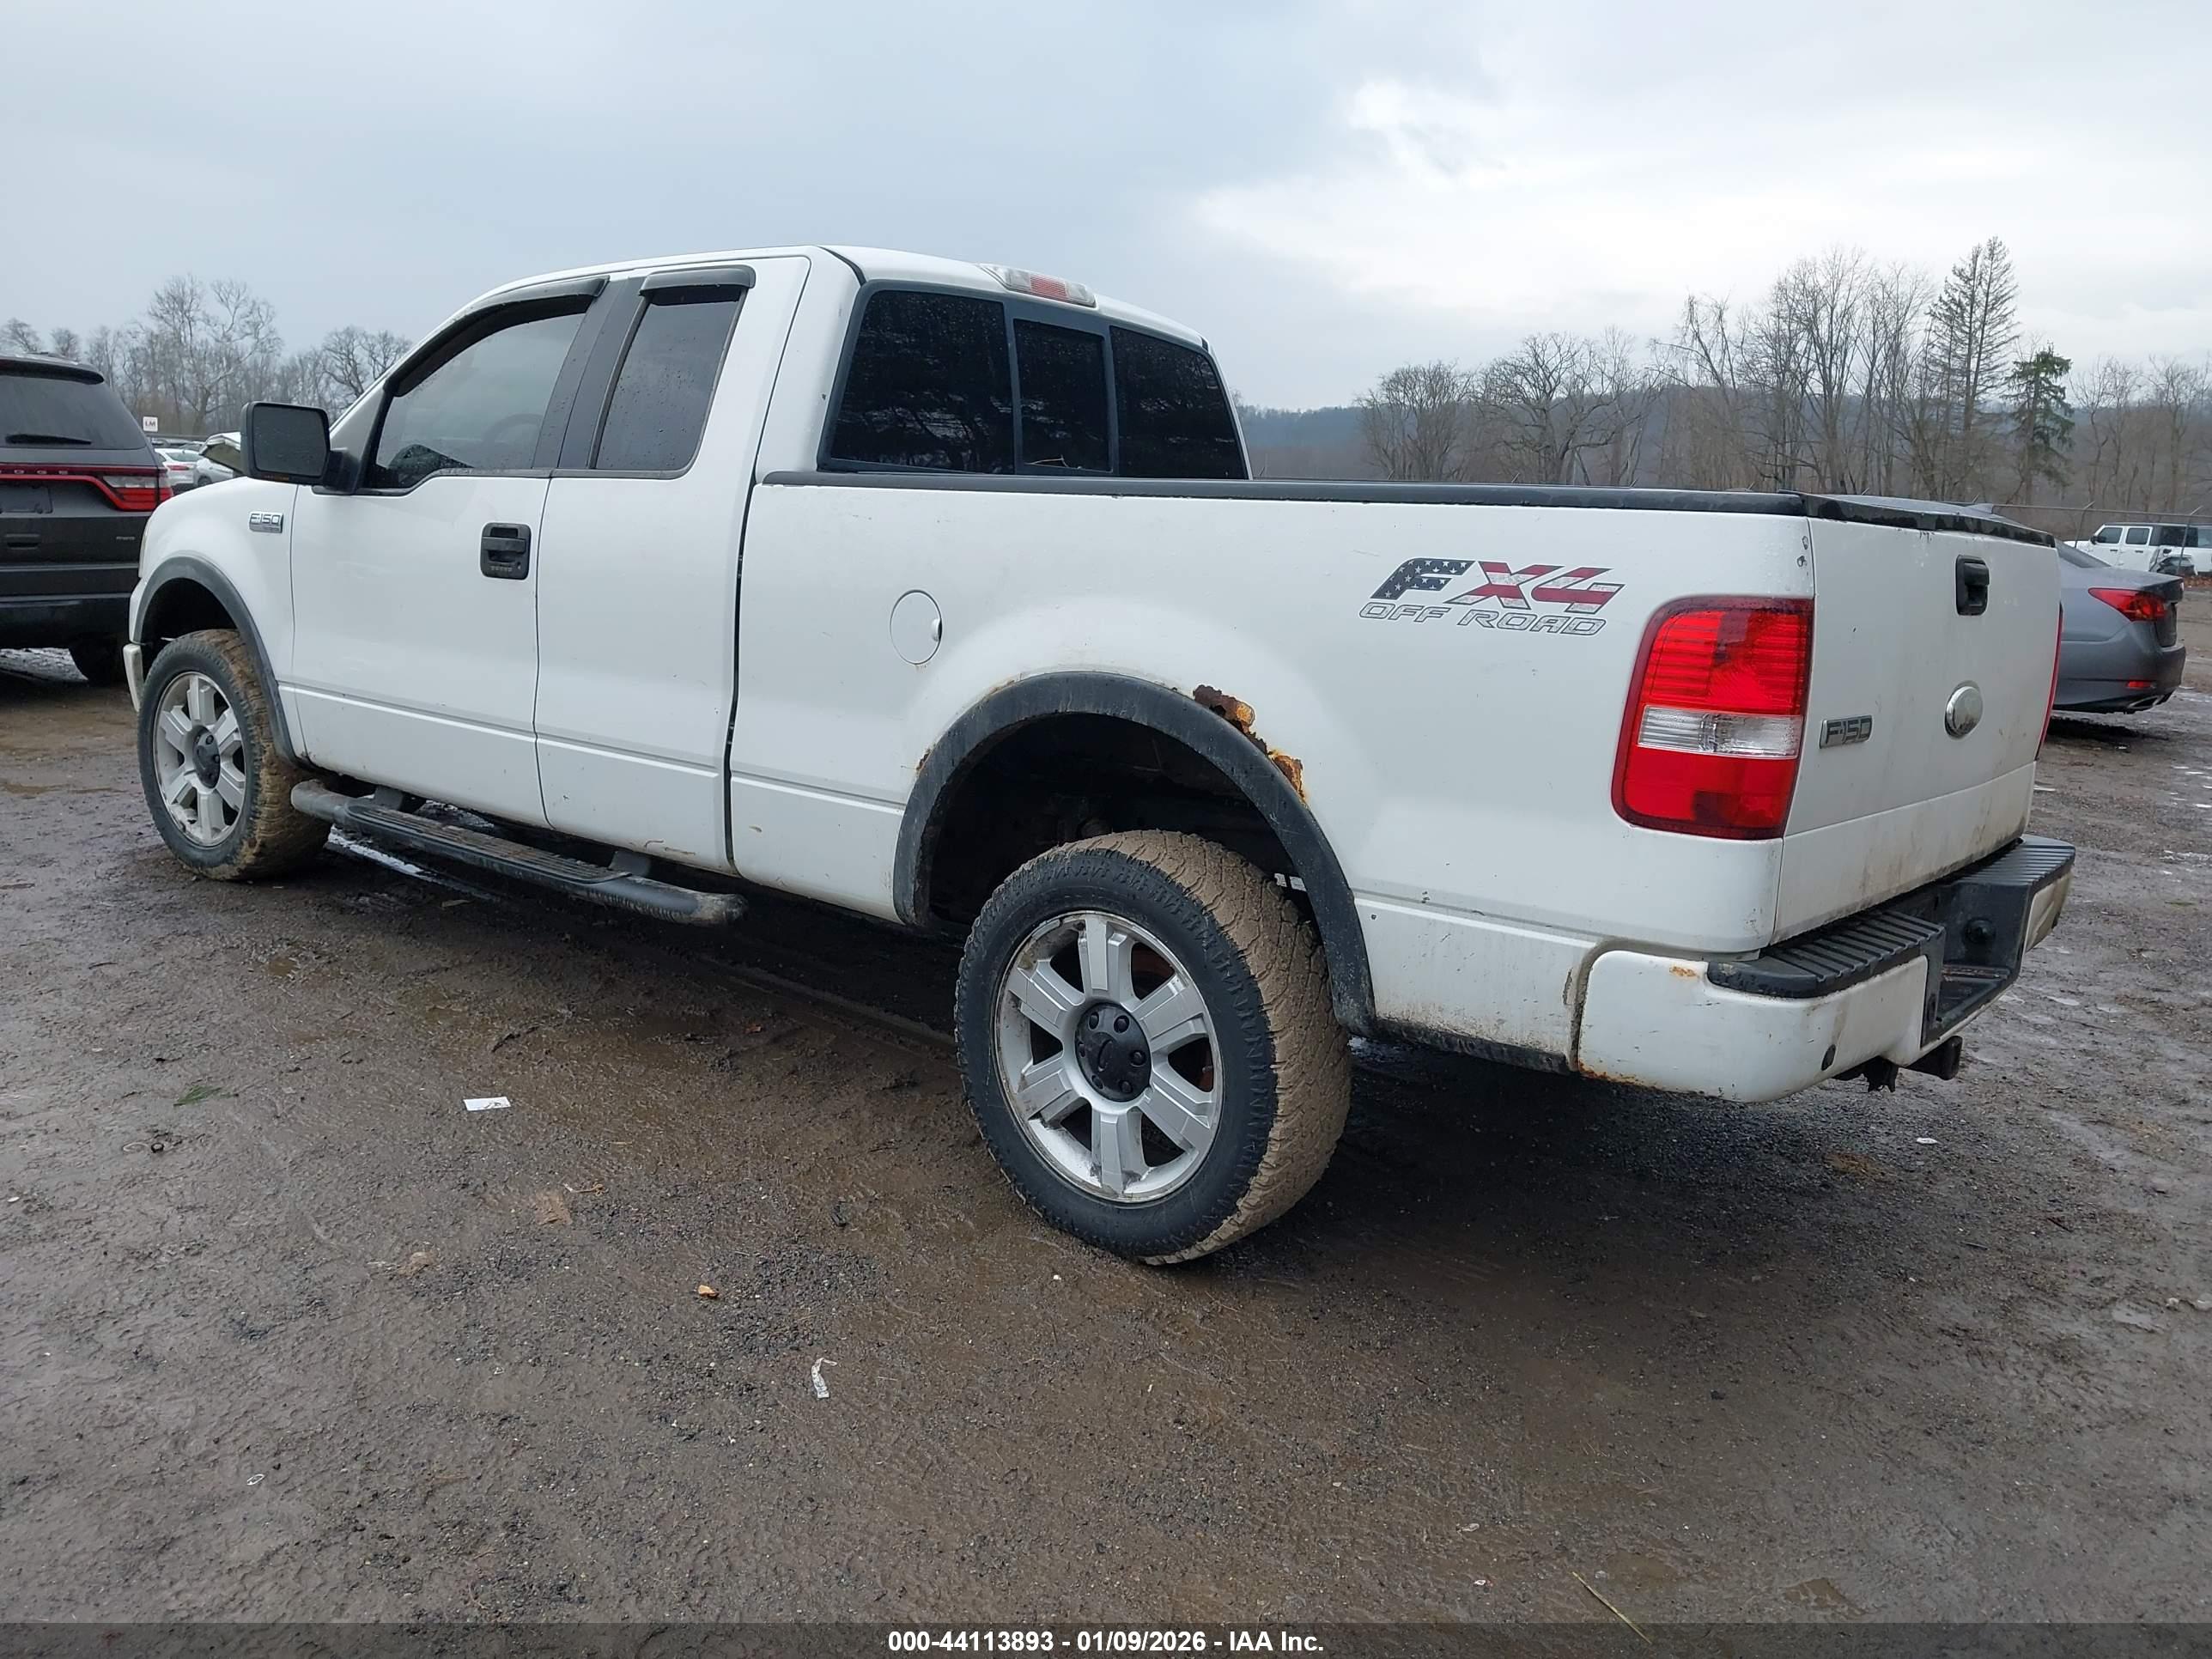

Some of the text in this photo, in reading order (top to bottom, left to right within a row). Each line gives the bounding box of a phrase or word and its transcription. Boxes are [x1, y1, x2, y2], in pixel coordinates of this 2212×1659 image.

[1369, 556, 1626, 615] FX4
[1358, 601, 1607, 636] OFF ROAD
